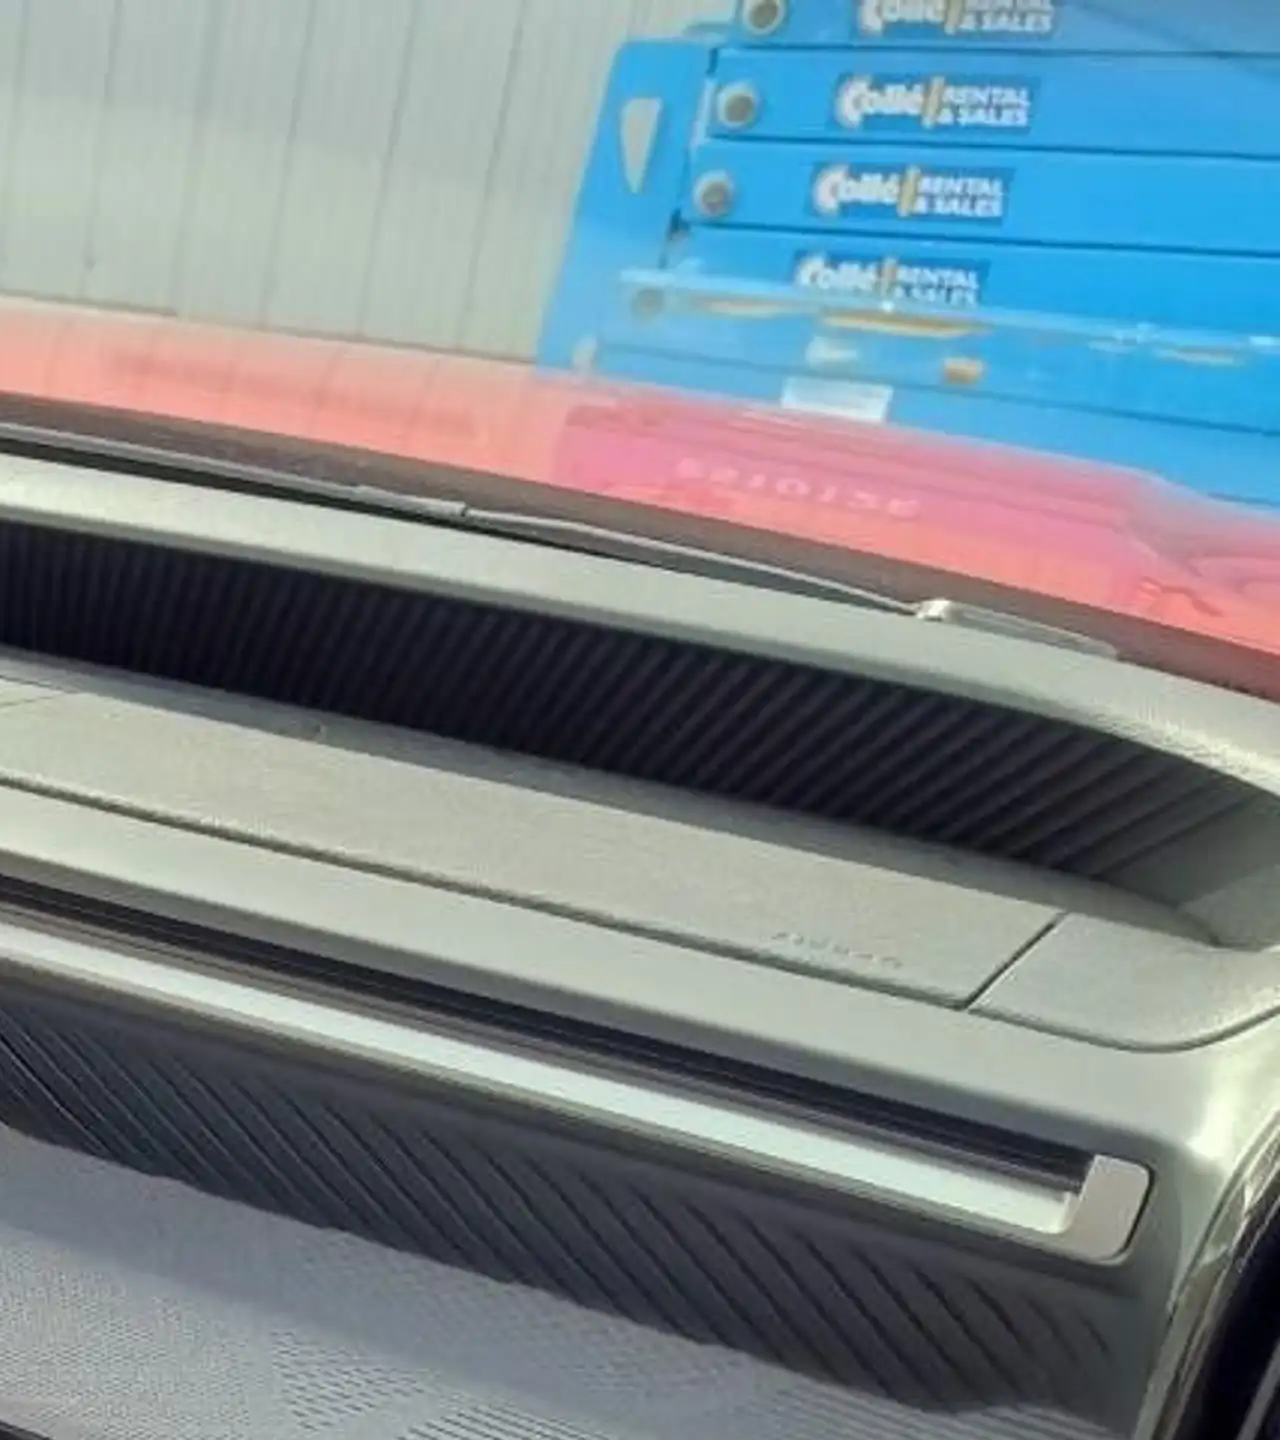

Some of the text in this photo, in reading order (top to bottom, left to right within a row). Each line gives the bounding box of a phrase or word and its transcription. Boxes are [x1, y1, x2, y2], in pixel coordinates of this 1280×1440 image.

[941, 84, 1030, 106] RENTAL
[957, 105, 1029, 128] SALES
[917, 176, 1004, 197] RENTAL
[934, 196, 1004, 218] SALES
